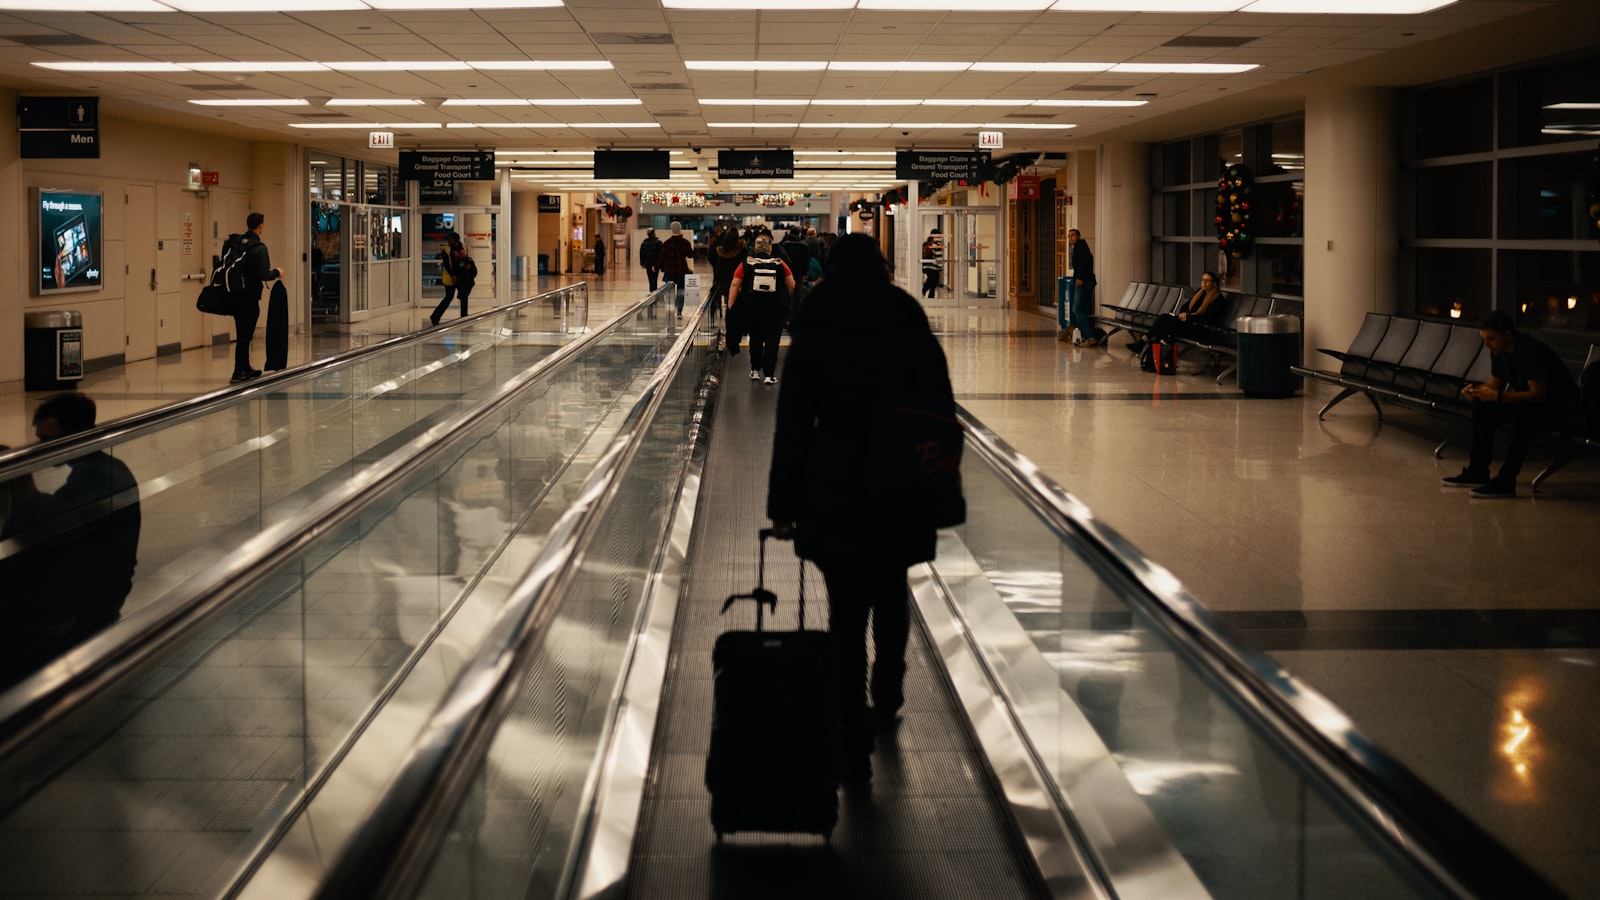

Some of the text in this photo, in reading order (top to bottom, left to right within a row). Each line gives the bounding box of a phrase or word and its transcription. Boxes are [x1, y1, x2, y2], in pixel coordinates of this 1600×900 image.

[71, 134, 94, 143] Men
[373, 134, 389, 144] EXIT
[982, 133, 1000, 144] EXIT
[422, 155, 451, 163] Baggage
[919, 155, 948, 163] Baggage
[440, 163, 471, 171] Transport
[937, 163, 968, 171] Transport
[720, 168, 743, 176] Moving
[745, 168, 774, 176] Walkway
[549, 196, 559, 204] B1
[49, 200, 64, 212] through
